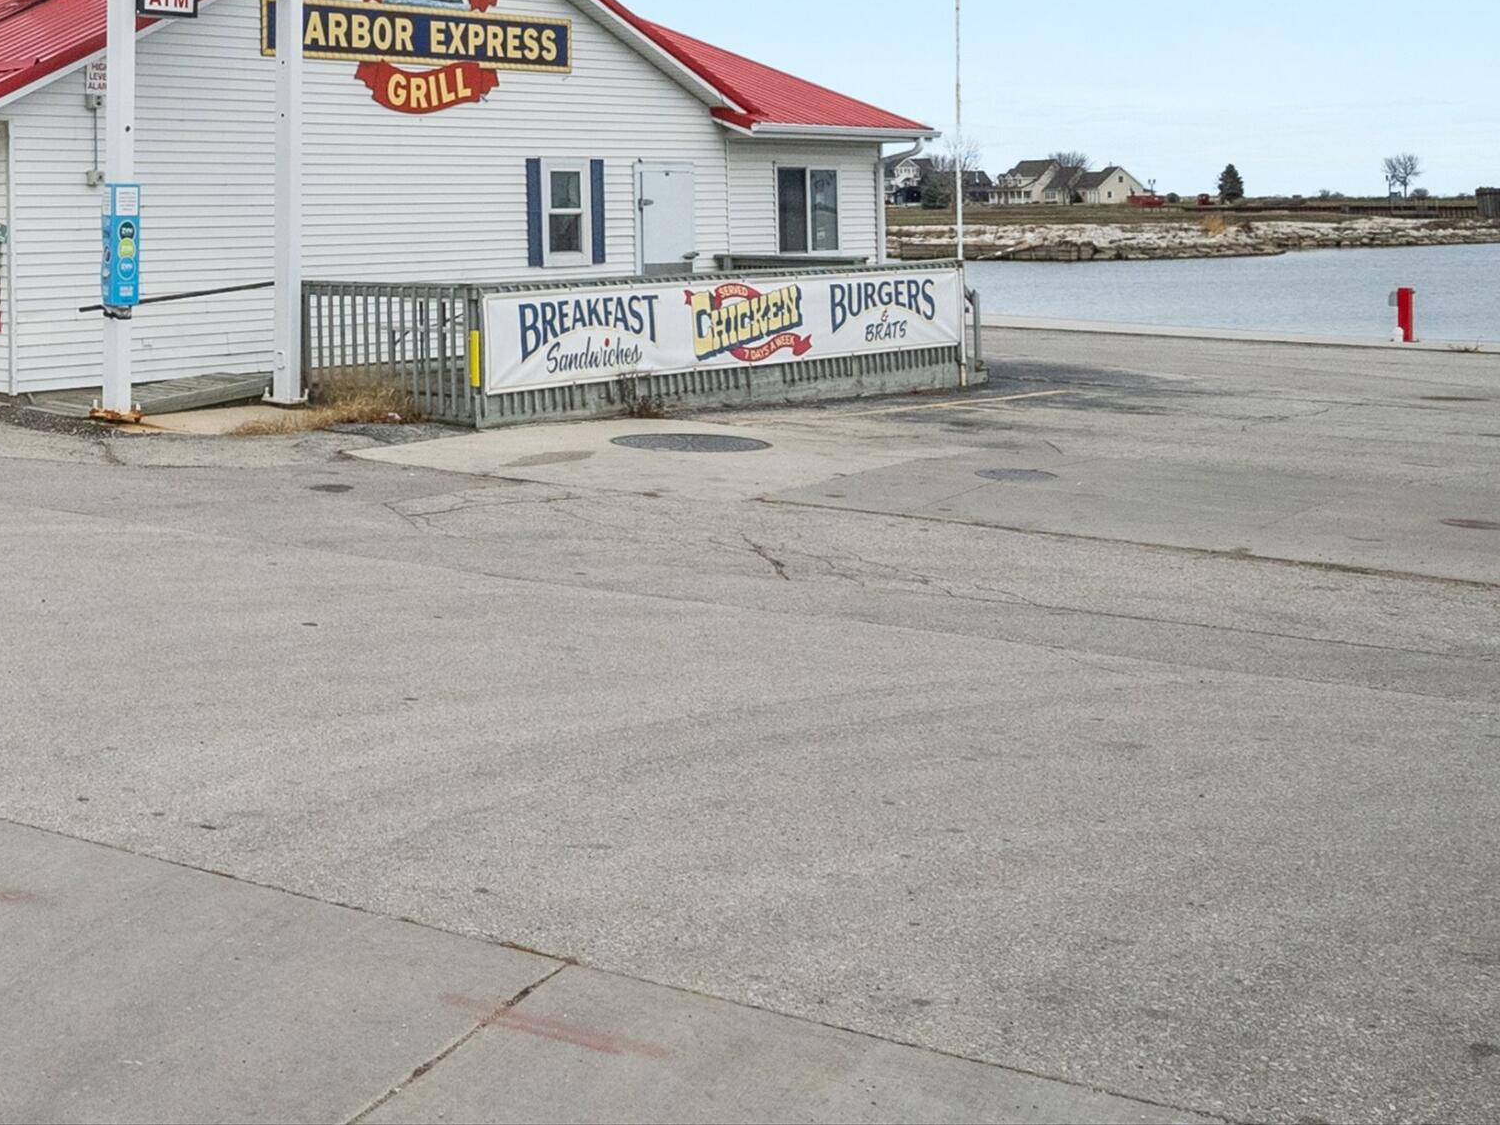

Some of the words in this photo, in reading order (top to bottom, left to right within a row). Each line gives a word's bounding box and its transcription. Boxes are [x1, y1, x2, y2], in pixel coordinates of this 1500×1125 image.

[303, 10, 414, 52] ARBOR
[429, 20, 558, 61] EXPRESS
[89, 73, 107, 82] LEVE
[91, 62, 107, 72] HIG
[88, 82, 107, 91] ALAR
[387, 67, 472, 109] GRILL
[718, 283, 749, 298] SERVED
[829, 278, 936, 334] BURGERS
[880, 308, 889, 323] &
[518, 294, 659, 363] BREAKFAST
[691, 283, 803, 361] CHICKEN
[865, 320, 908, 343] BRATS
[546, 336, 643, 374] Sandwiches
[750, 345, 771, 360] DAYS
[775, 333, 796, 347] WEEK
